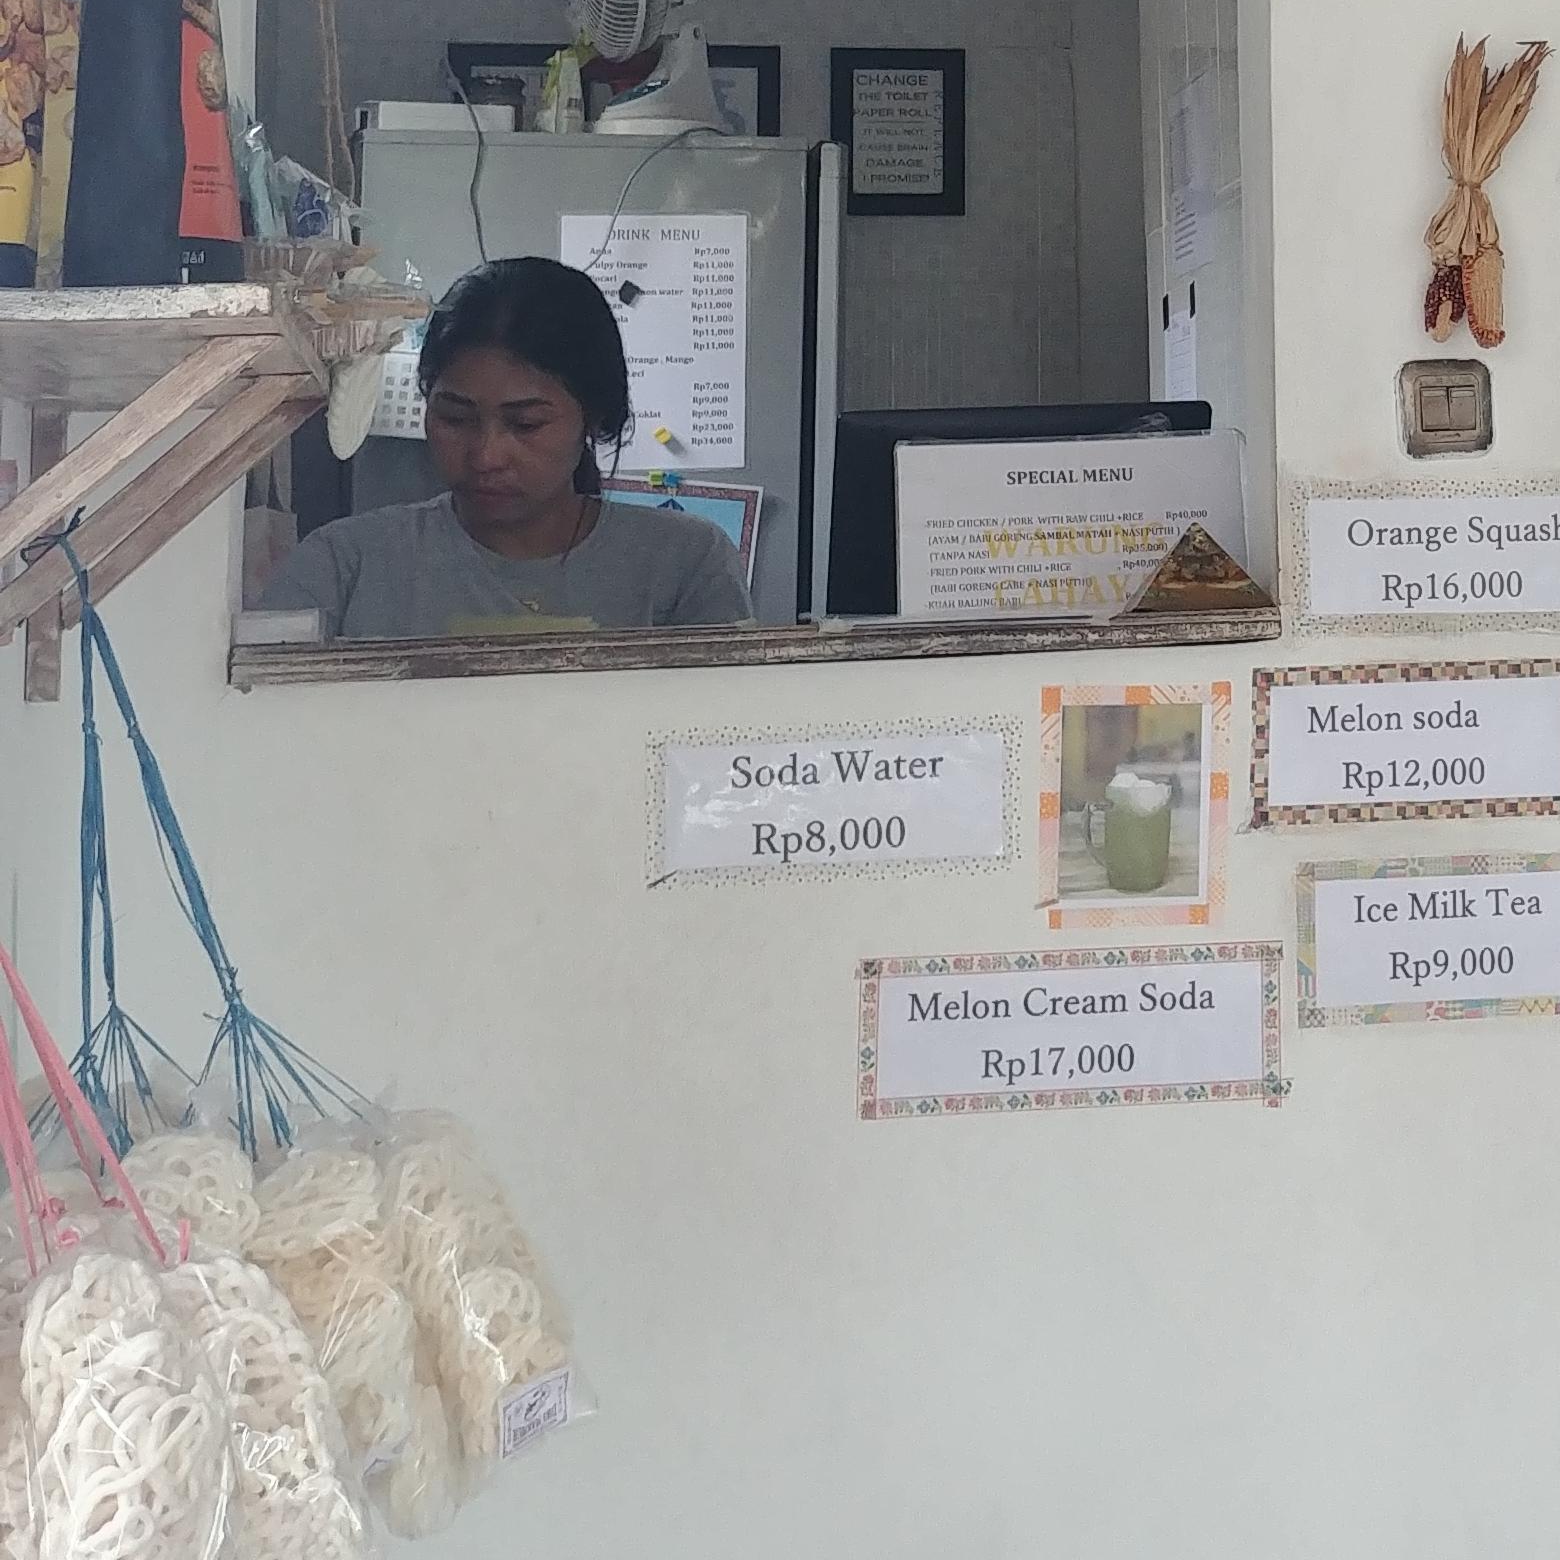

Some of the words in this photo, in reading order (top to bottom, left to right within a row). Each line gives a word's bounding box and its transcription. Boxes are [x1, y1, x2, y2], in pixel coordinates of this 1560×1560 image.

[856, 75, 929, 86] CHANGE
[885, 92, 929, 101] TOILET
[898, 108, 933, 117] ROLL
[866, 159, 925, 168] DAMAGE
[661, 229, 701, 241] MENU
[694, 247, 730, 258] Rp7,000
[617, 261, 649, 271] Orange
[693, 261, 735, 271] Rp11,000
[693, 274, 735, 285] Rp11,000
[659, 287, 685, 296] water
[692, 288, 734, 298] Rp11,000
[691, 301, 733, 312] Rp11,000
[692, 315, 734, 325] Rp11,000
[692, 328, 734, 339] Rp11,000
[693, 341, 735, 352] Rp11,000
[665, 355, 694, 365] Mango
[694, 382, 730, 393] Rp7,000
[693, 396, 729, 407] Rp9,000
[692, 409, 728, 420] Rp9,000
[1006, 468, 1079, 485] SPECIAL
[1083, 467, 1134, 483] MENU
[957, 518, 998, 528] CHICKEN
[1008, 516, 1034, 527] PORK
[1038, 515, 1064, 525] WITH
[1065, 514, 1088, 524] RAW
[1090, 513, 1115, 523] CHILI
[1165, 510, 1209, 522] Rp40,000
[1033, 530, 1075, 540] SAMBAL
[1121, 528, 1143, 538] NASI
[1347, 518, 1458, 551] Orange
[968, 550, 990, 559] NASI
[960, 566, 986, 576] PORK
[988, 565, 1015, 574] WITH
[1016, 563, 1042, 573] CHILI
[958, 582, 998, 592] GORENG
[1381, 570, 1523, 608] Rp16,000
[1307, 703, 1404, 734] Melon
[1413, 699, 1480, 730] soda
[730, 751, 821, 789] Soda
[831, 749, 944, 783] Water
[1341, 756, 1486, 797] Rp12,000
[751, 815, 907, 863] Rp8,000
[1353, 895, 1398, 924] Ice
[1407, 888, 1478, 921] Milk
[1485, 887, 1543, 917] Tea
[1388, 946, 1514, 987] Rp9,000
[907, 990, 1012, 1022] Melon
[1023, 987, 1129, 1018] Cream
[1139, 980, 1216, 1012] Soda
[981, 1043, 1136, 1086] Rp17,000
